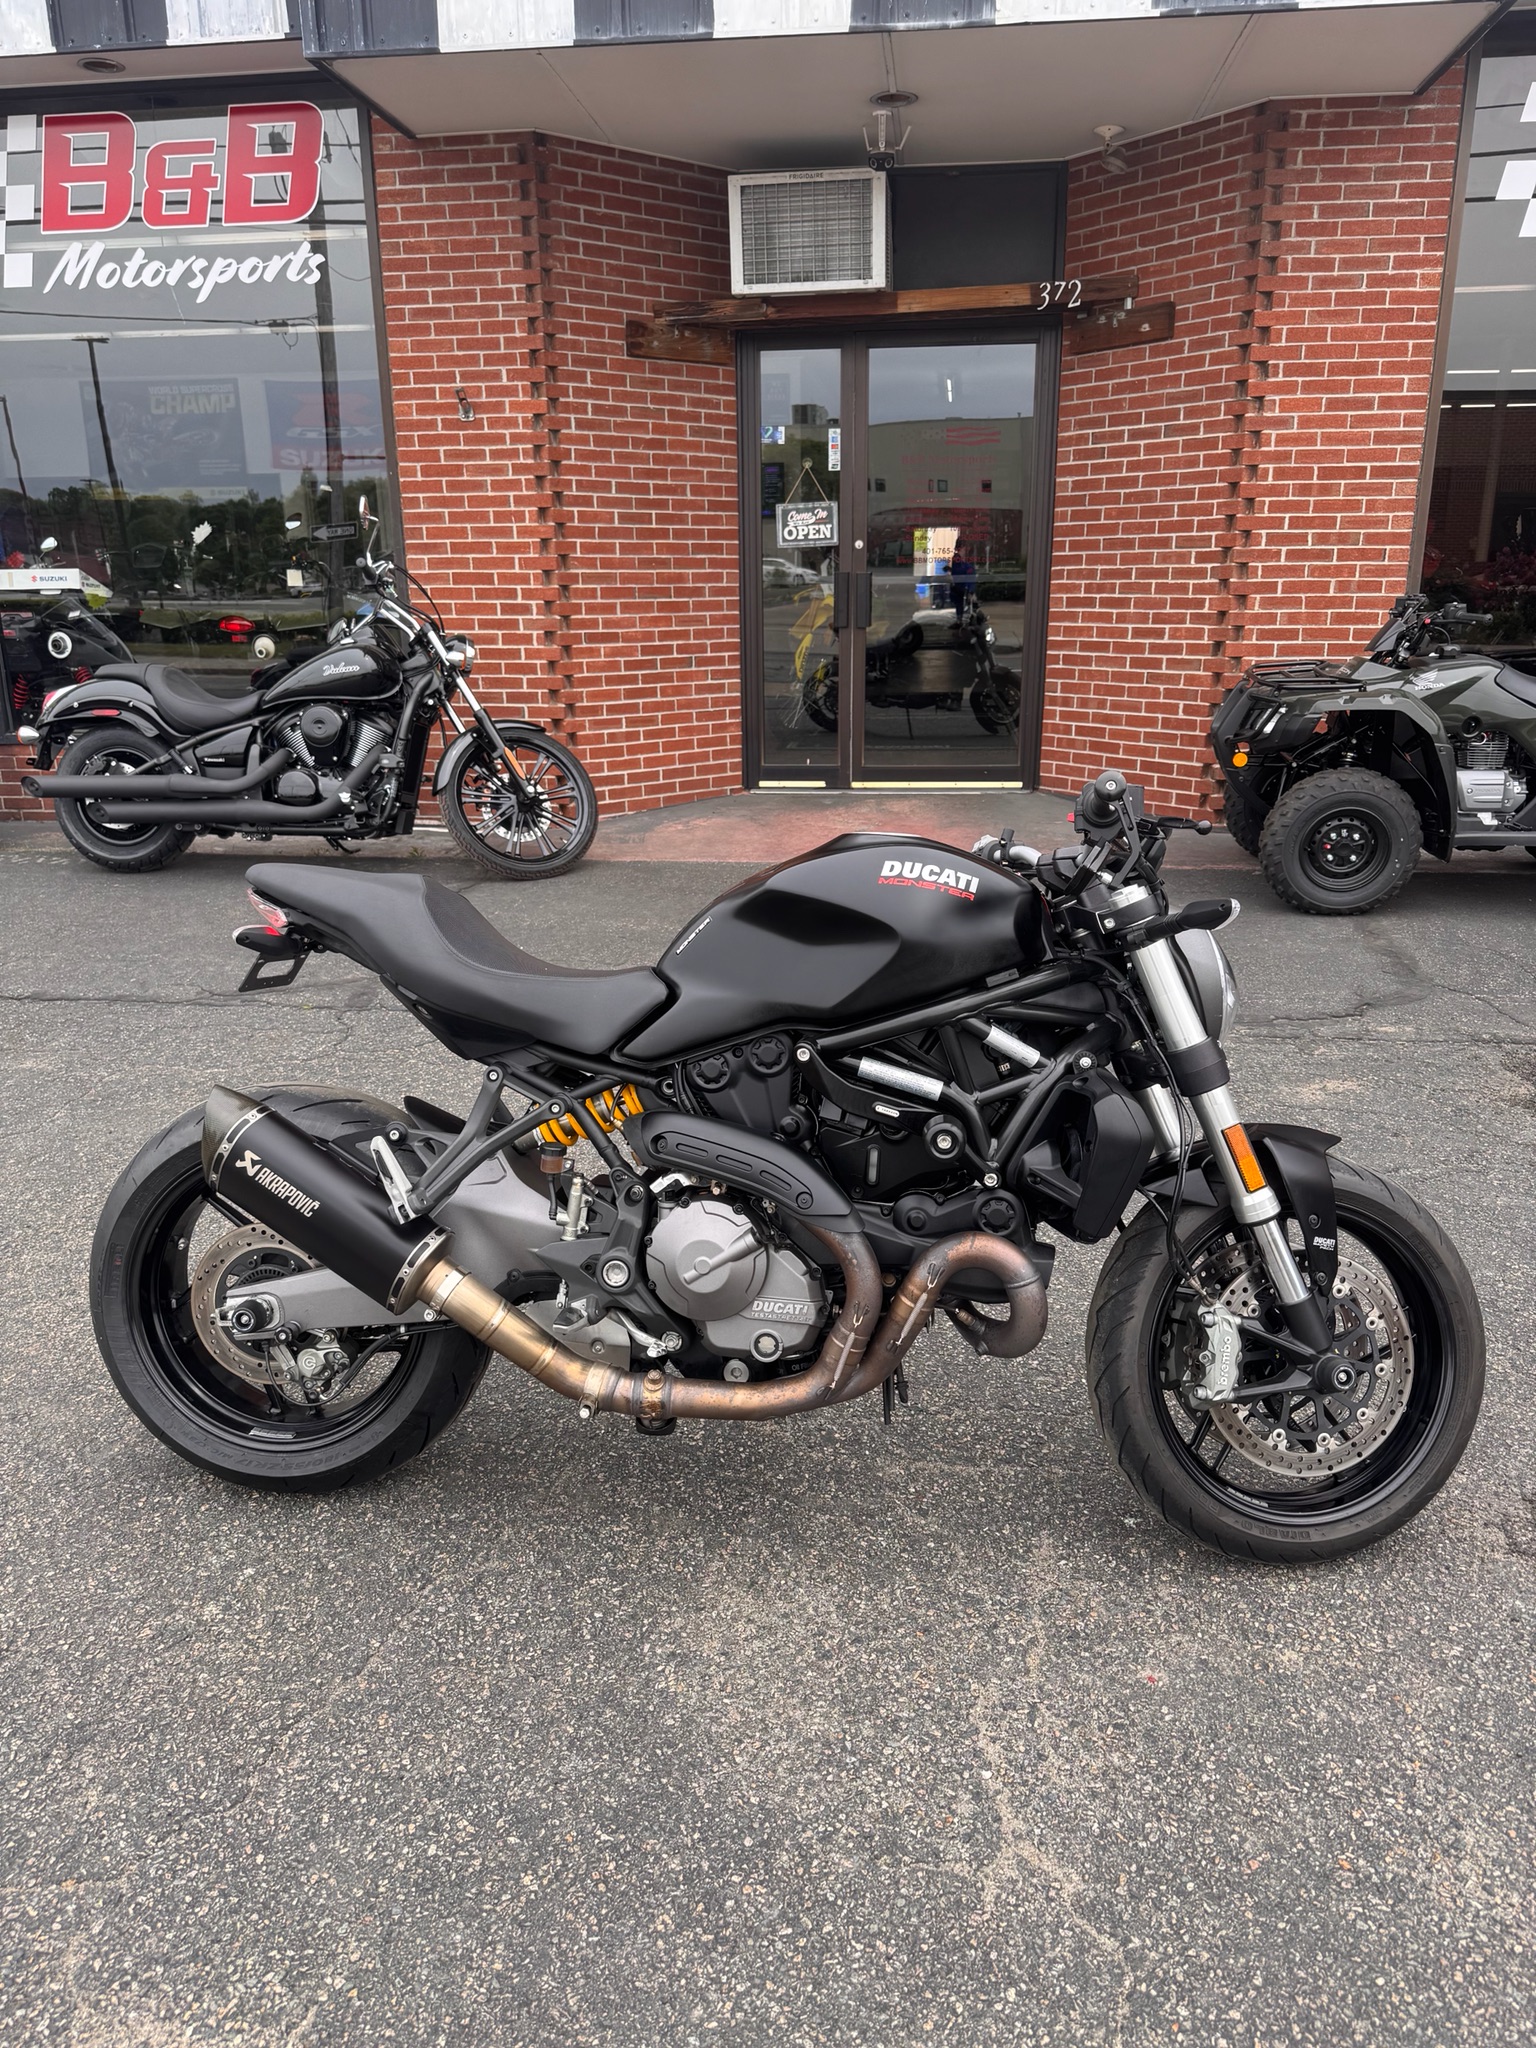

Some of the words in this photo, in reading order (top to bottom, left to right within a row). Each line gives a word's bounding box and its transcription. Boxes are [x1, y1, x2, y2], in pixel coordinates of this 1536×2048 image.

[41, 100, 325, 235] B&B
[788, 172, 824, 180] FRIGIDAIRE
[43, 240, 326, 304] Motorsports
[1037, 279, 1082, 310] 372
[150, 393, 236, 415] CHAMP
[787, 510, 812, 522] Come
[814, 508, 829, 520] In
[783, 523, 833, 541] OPEN
[39, 575, 68, 583] SUZUKI
[1414, 682, 1446, 691] HONDA
[879, 859, 980, 894] DUCATI
[877, 876, 976, 902] MONSTER
[675, 916, 711, 955] MONSTER
[751, 1300, 808, 1315] DUCATI
[1217, 1336, 1232, 1386] brembo
